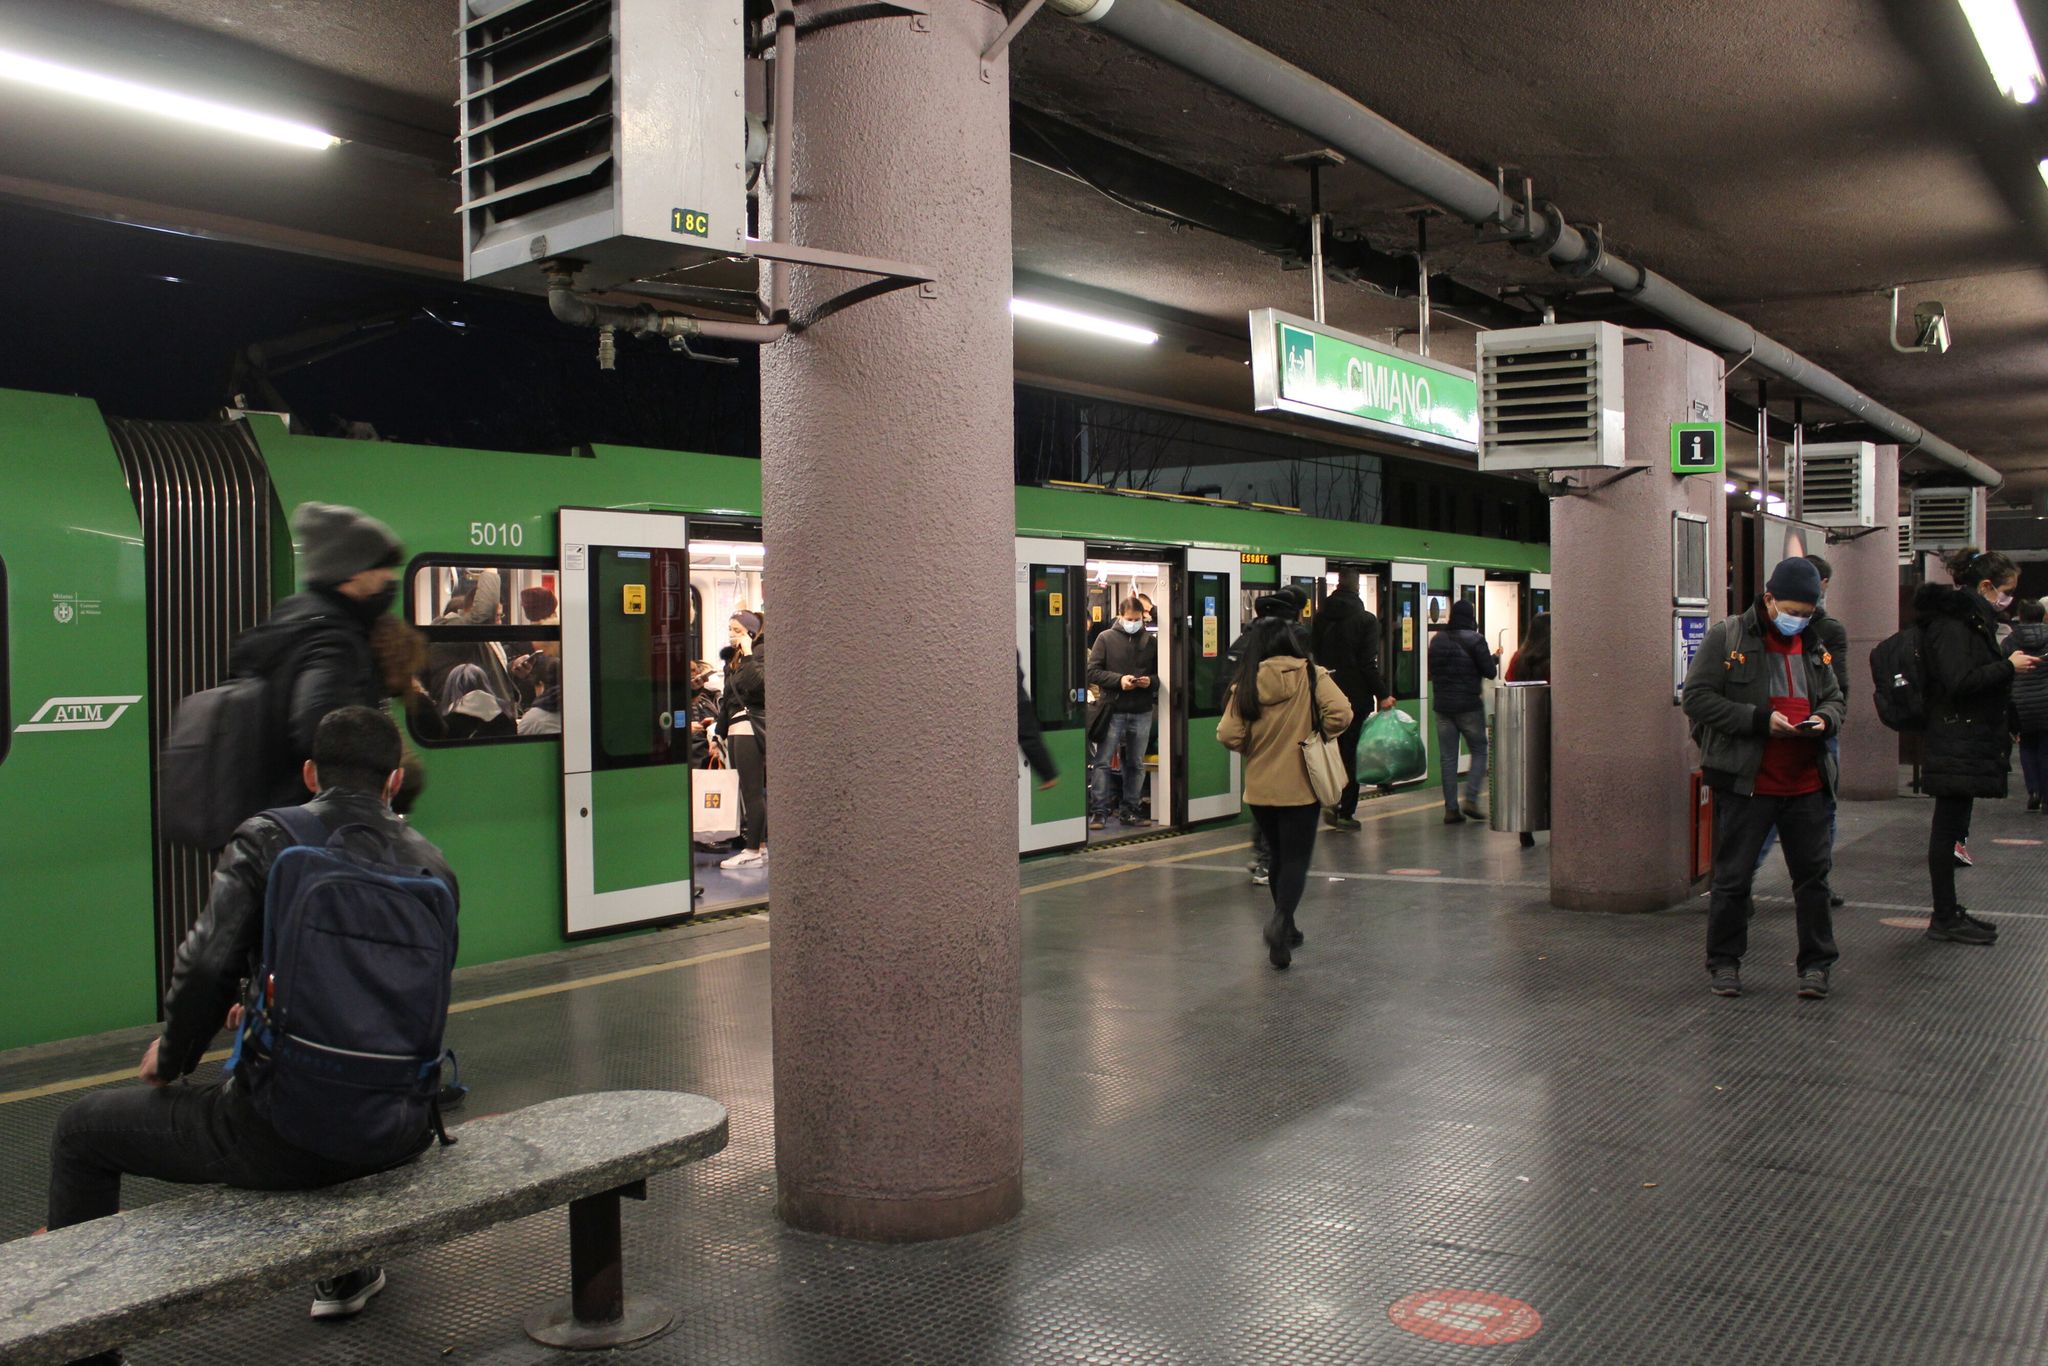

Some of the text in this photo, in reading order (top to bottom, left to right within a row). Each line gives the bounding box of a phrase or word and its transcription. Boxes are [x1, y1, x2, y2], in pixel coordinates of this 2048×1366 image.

[674, 212, 706, 233] 18C
[1347, 356, 1431, 416] CIMIANO
[1691, 436, 1703, 460] i
[471, 522, 522, 547] 5010
[53, 705, 103, 722] ATM
